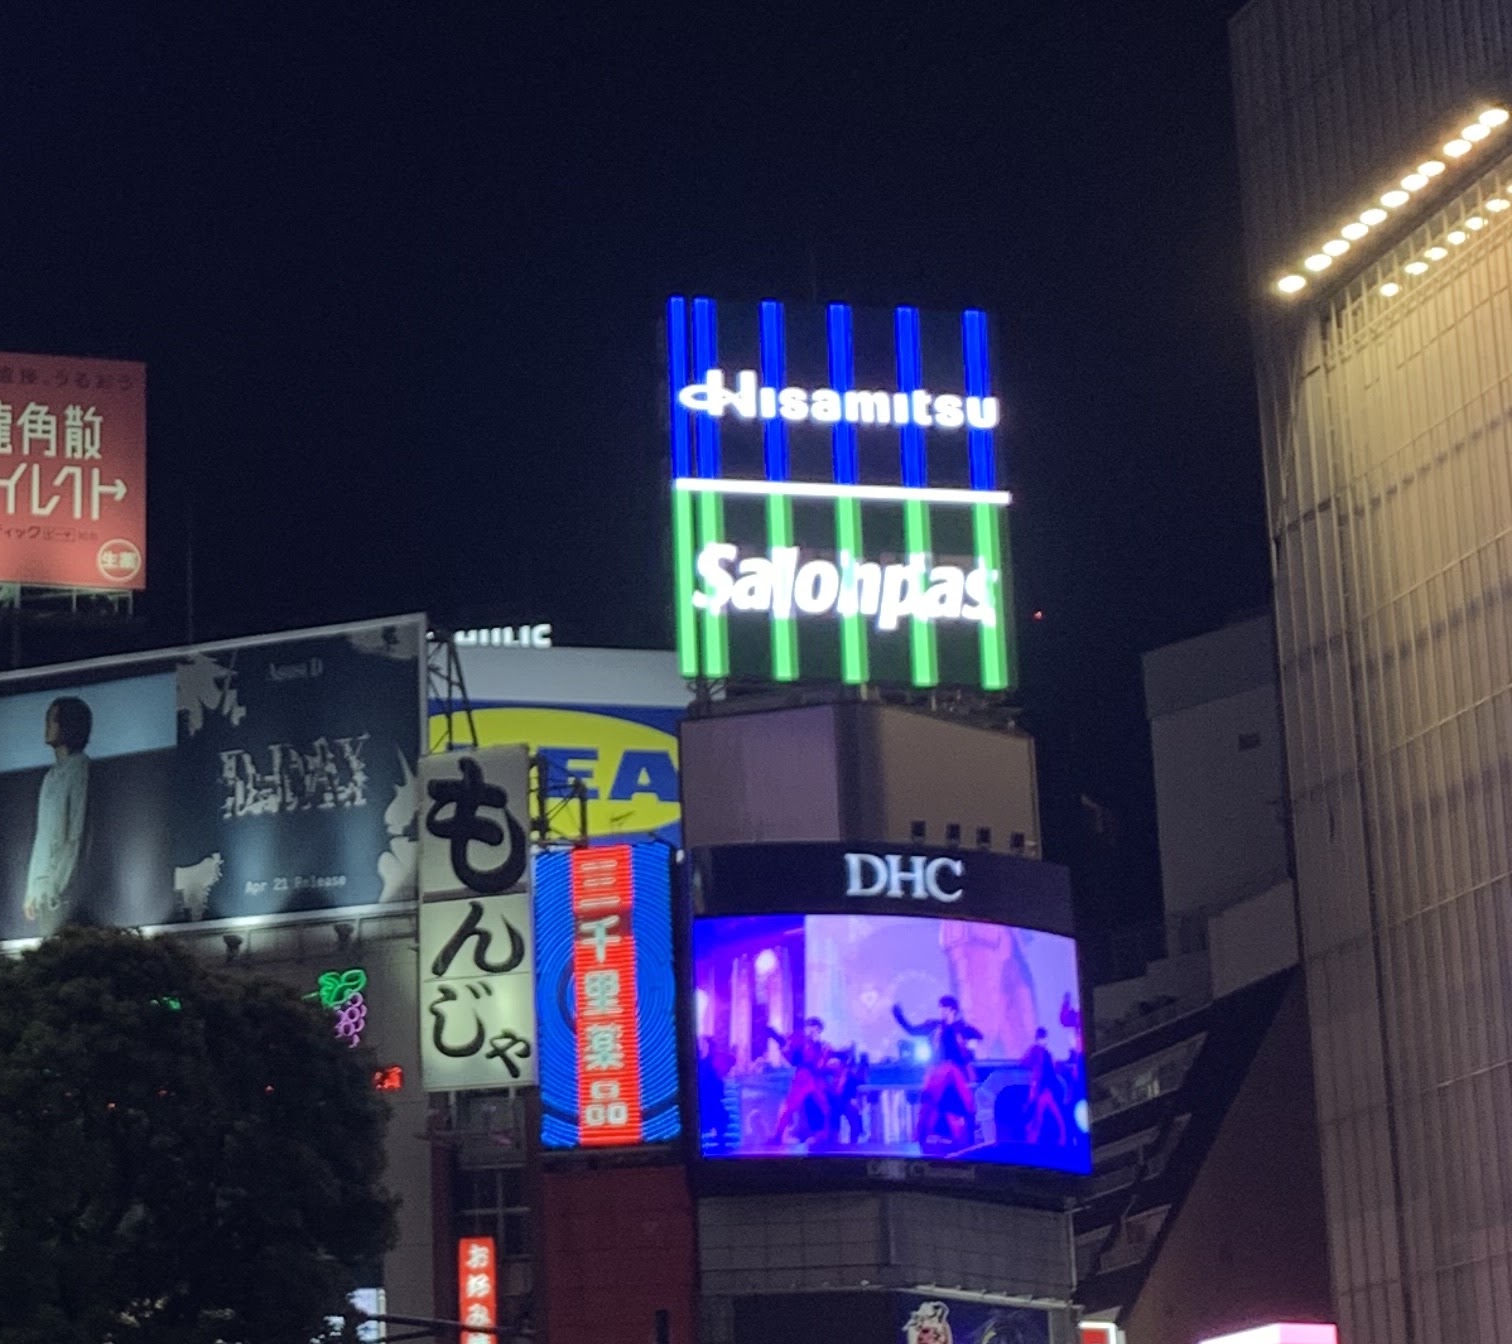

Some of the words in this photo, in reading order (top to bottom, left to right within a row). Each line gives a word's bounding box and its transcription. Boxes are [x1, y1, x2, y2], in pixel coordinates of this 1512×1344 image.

[678, 368, 1001, 429] Hisamitsu
[691, 541, 1000, 631] Salonpas
[425, 756, 532, 1080] もんじゃ
[844, 851, 966, 904] DHC
[579, 858, 629, 1126] 三千里薬品
